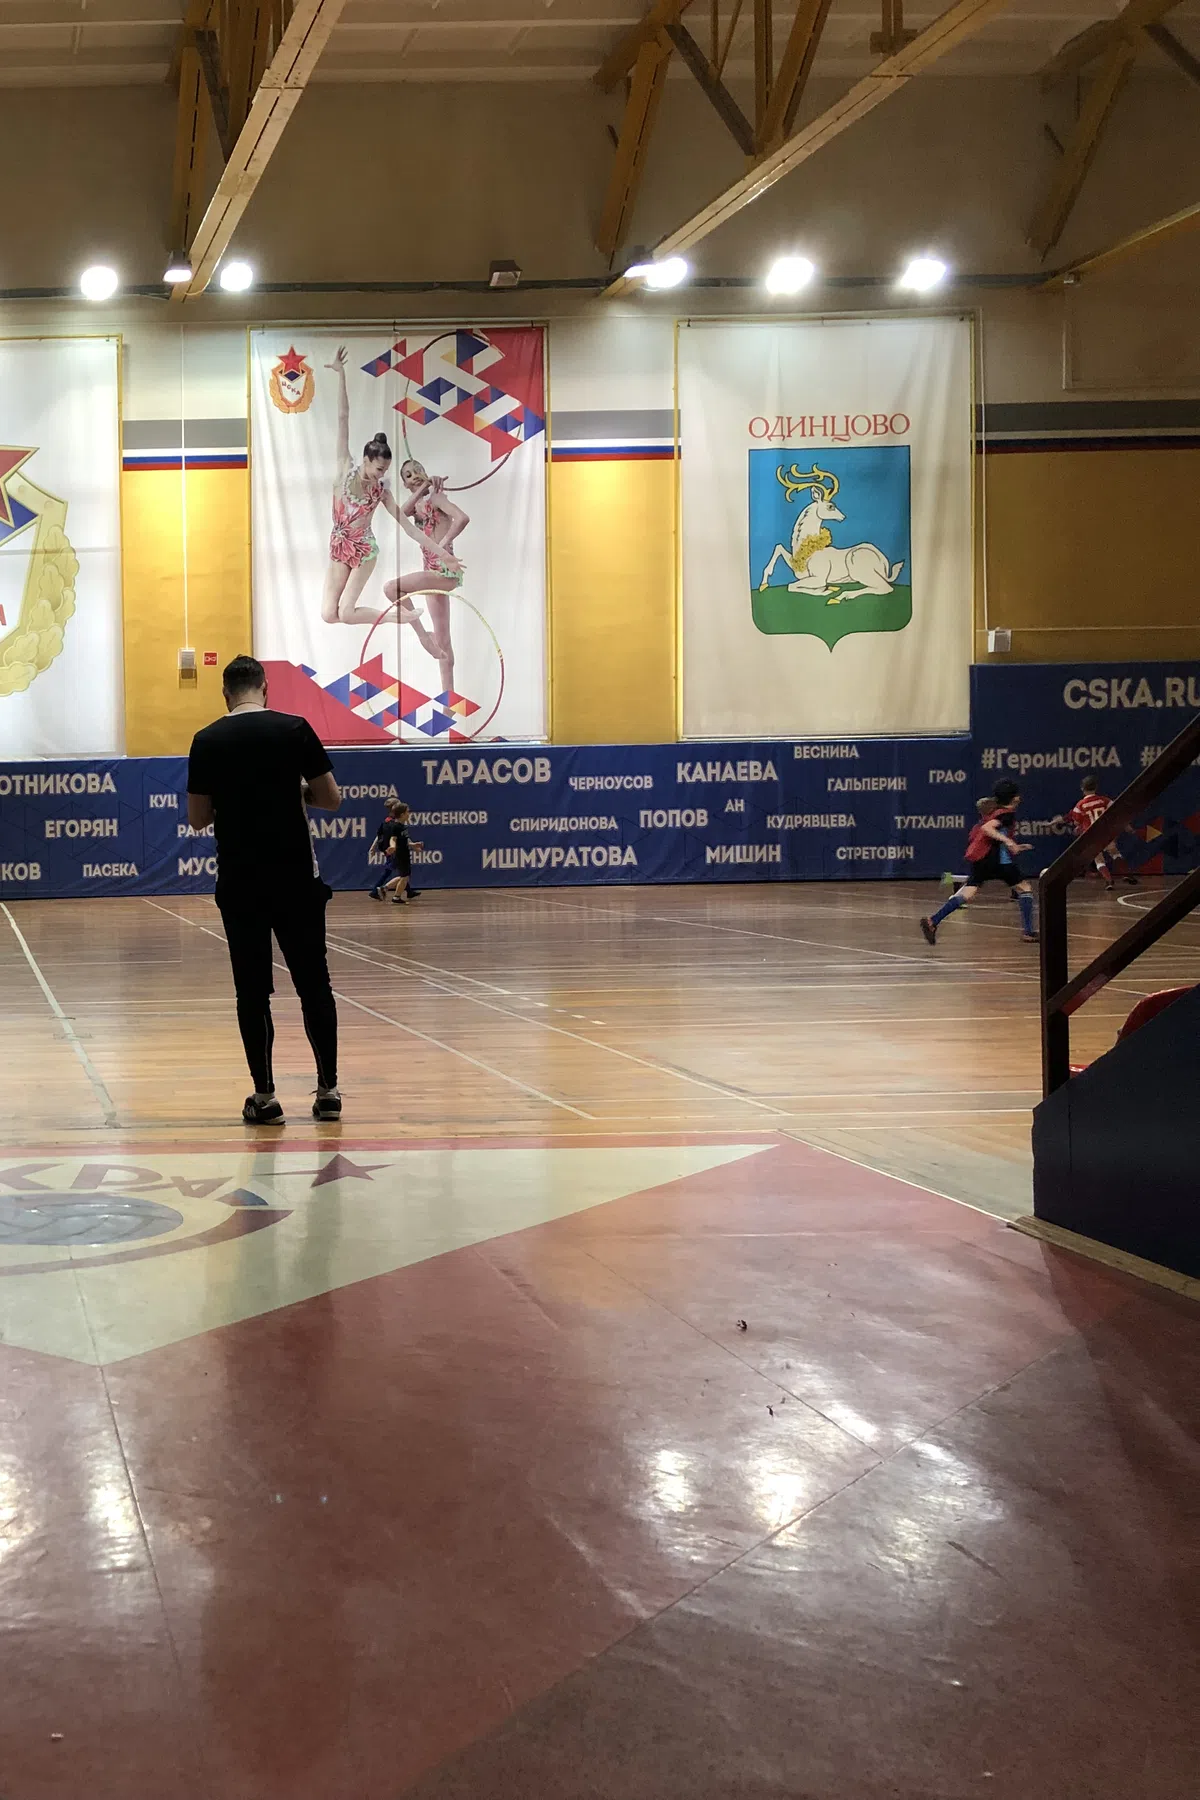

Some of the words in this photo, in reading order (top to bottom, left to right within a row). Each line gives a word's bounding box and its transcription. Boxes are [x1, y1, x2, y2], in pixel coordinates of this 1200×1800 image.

[748, 413, 910, 442] ОДИНЦОВО
[1062, 677, 1200, 709] CSKA.RU
[794, 745, 859, 759] ВЕСНИНА
[981, 746, 1122, 775] #ГероиЦСКА
[423, 758, 551, 784] ТАРАСОВ
[677, 761, 778, 782] КАНАЕВА
[929, 770, 966, 783] ГРАФ
[569, 776, 653, 790] ЧЕРНОУСОВ
[828, 777, 906, 791] ГАЛЬПЕРИН
[150, 794, 178, 808] КУЦ
[725, 799, 744, 812] АН
[510, 816, 618, 832] СПИРИДОНОВА
[640, 809, 708, 827] ПОПОВ
[767, 814, 855, 829] КУДРЯВЦЕВА
[894, 816, 964, 828] ТУТХАЛЯН
[46, 819, 118, 837] ЕГОРЯН
[308, 817, 367, 839] АМУН
[483, 846, 637, 868] ИШМУРАТОВА
[706, 845, 781, 863] МИШИН
[836, 846, 913, 859] СТРЕТОВИЧ
[83, 863, 138, 877] ПАСЕКА
